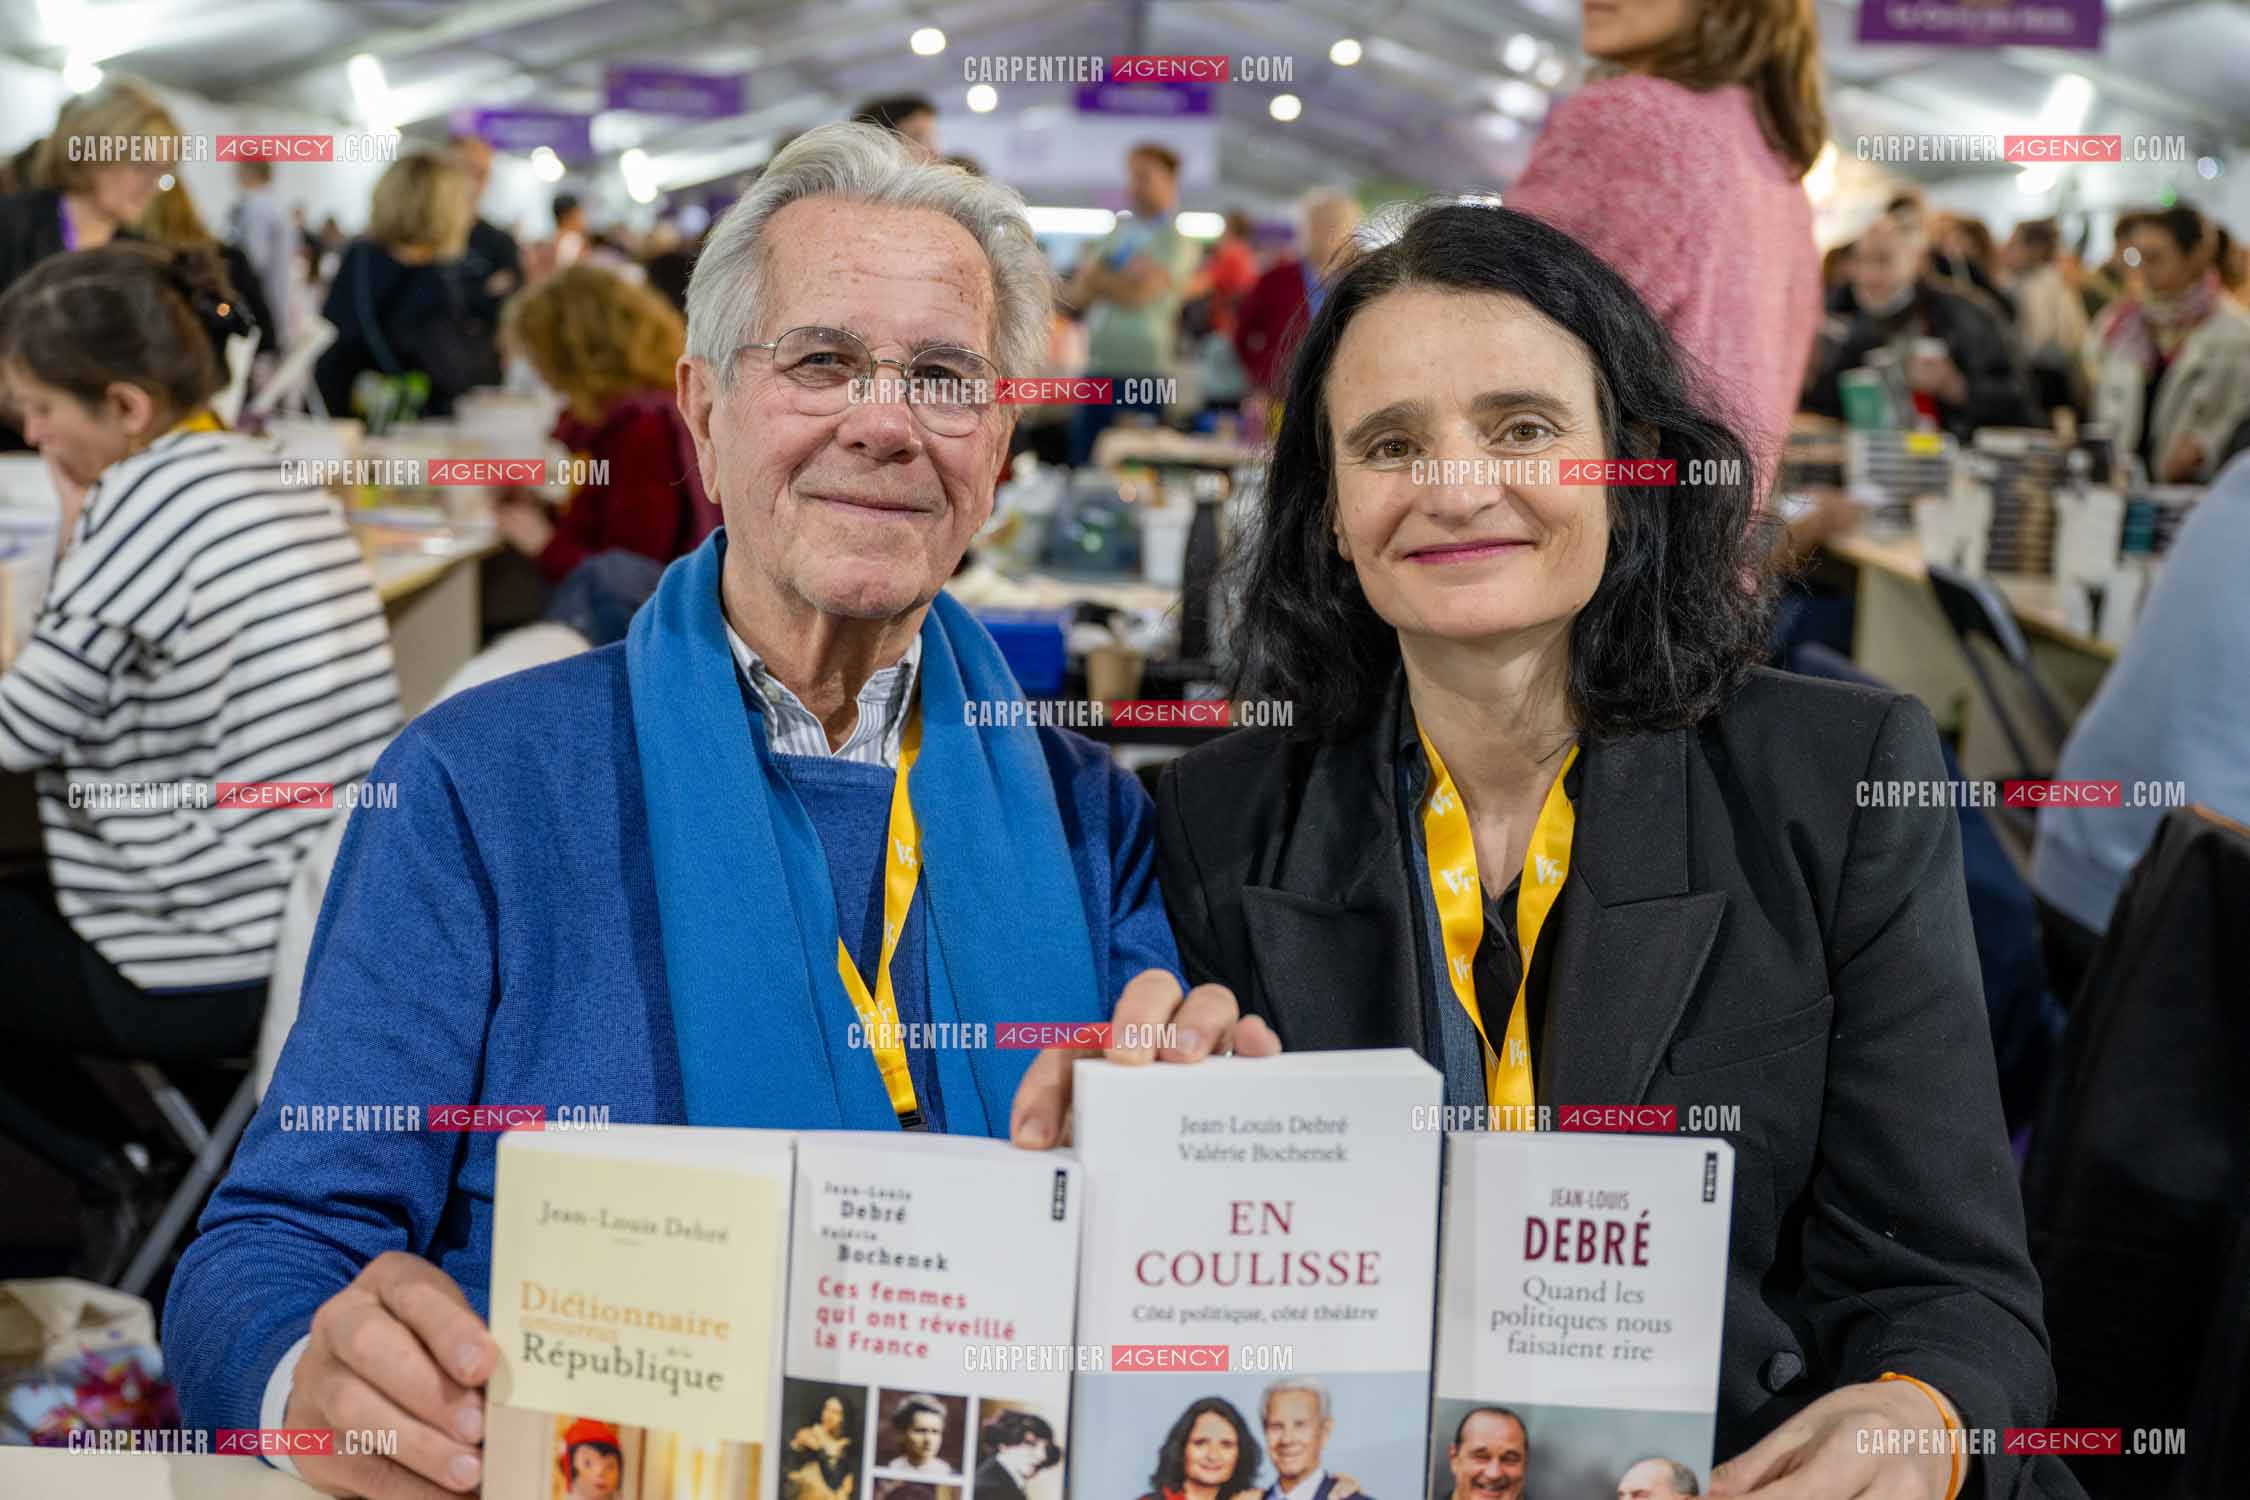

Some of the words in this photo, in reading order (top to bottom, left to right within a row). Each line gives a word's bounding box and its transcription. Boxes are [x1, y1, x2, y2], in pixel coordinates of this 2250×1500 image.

[1180, 1116, 1283, 1137] Jean-Louis
[1288, 1116, 1349, 1136] Debré
[1178, 1143, 1246, 1162] Valérie
[1251, 1144, 1351, 1162] Bochenek
[840, 1201, 907, 1222] Debré
[1550, 1188, 1631, 1211] JEAN-LOUIS
[1229, 1200, 1295, 1236] EN
[1523, 1208, 1651, 1267] DEBRÉ
[837, 1244, 949, 1272] Bochenek
[1135, 1250, 1382, 1286] COULISSE
[817, 1276, 859, 1298] Ces
[869, 1281, 968, 1310] femmes
[1522, 1276, 1606, 1304] Quand
[1615, 1281, 1645, 1304] les
[520, 1280, 730, 1342] Dictionnaire
[816, 1307, 855, 1326] qui
[866, 1311, 908, 1330] ont
[919, 1315, 1016, 1341] réveillé
[1132, 1304, 1174, 1322] Côté
[1179, 1304, 1266, 1325] politique,
[1271, 1305, 1308, 1322] côté
[1312, 1304, 1379, 1322] théâtre
[1490, 1305, 1609, 1337] politiques
[1616, 1315, 1673, 1334] nous
[815, 1328, 837, 1349] la
[848, 1333, 928, 1359] France
[1508, 1331, 1605, 1360] faisaient
[1612, 1339, 1655, 1361] rire
[522, 1332, 724, 1397] République
